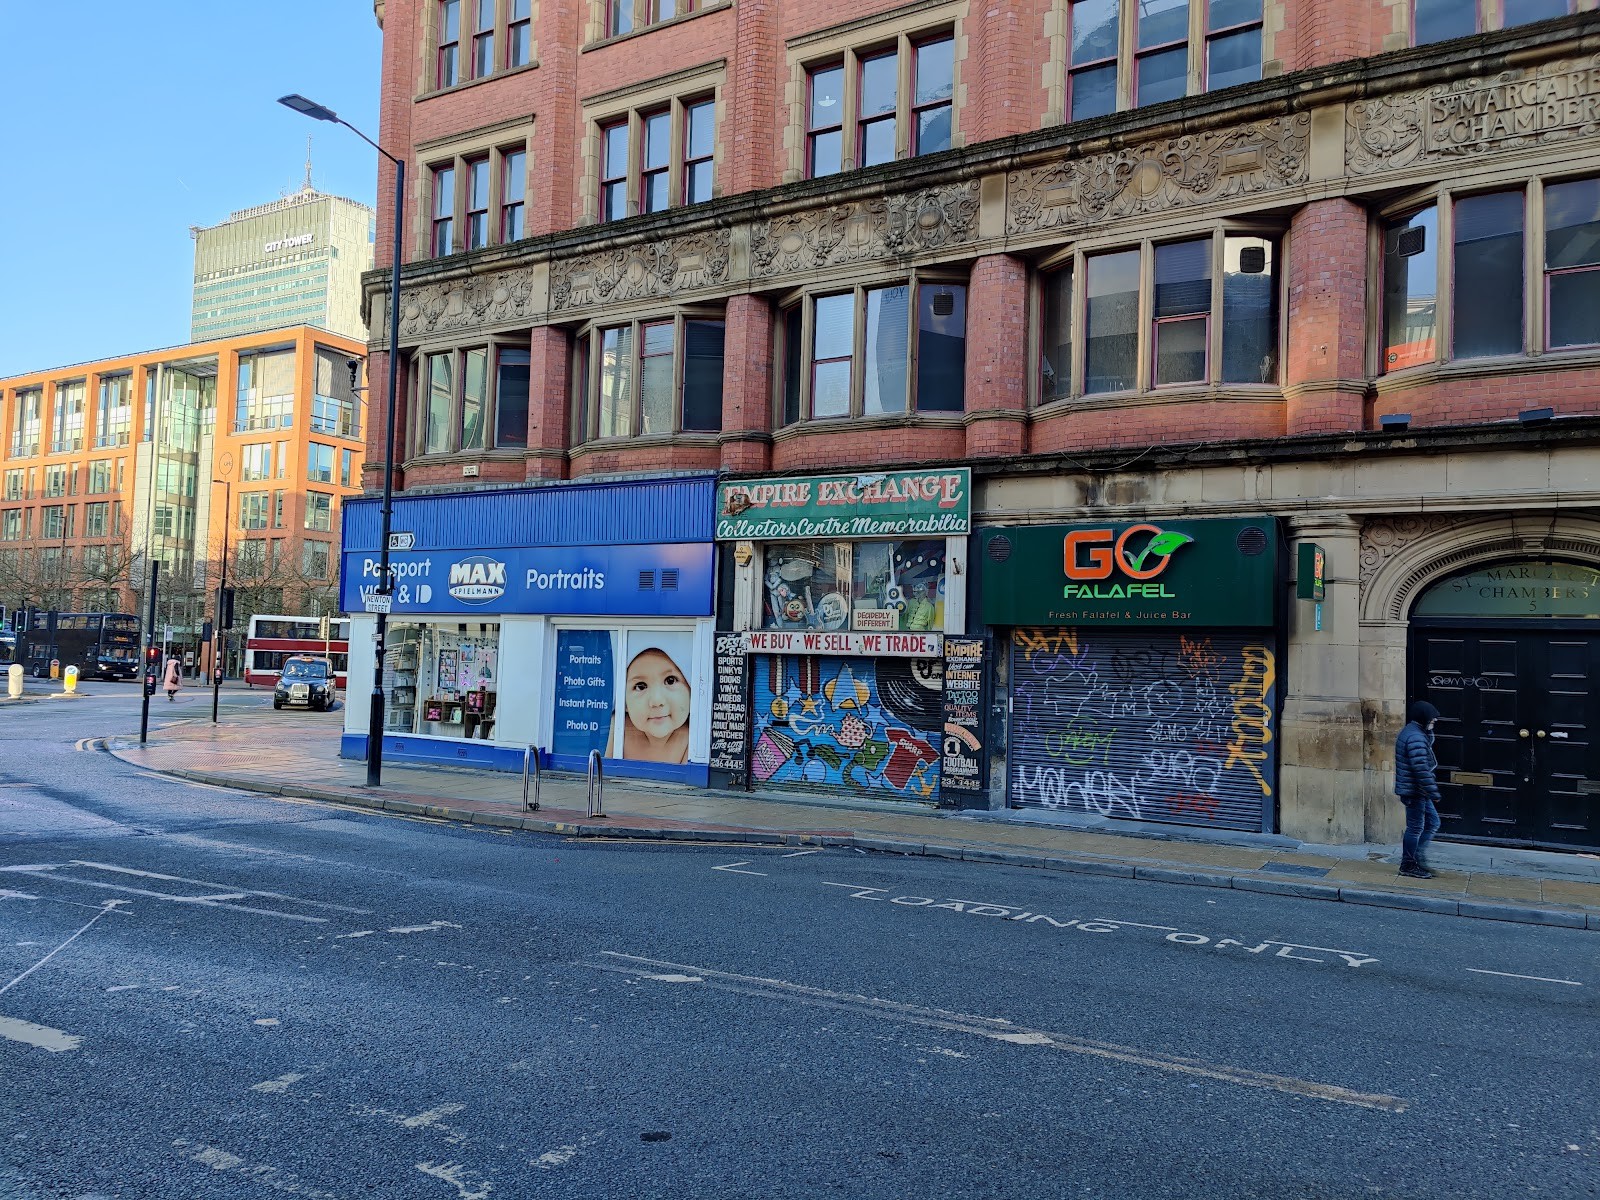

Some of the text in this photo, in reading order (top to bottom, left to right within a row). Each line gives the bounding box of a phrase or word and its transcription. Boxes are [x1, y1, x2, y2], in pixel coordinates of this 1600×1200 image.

[265, 234, 313, 253] CITY TOWER
[816, 474, 963, 508] EXCHANGE
[716, 513, 968, 539] Collectors Centre Memorabilia
[1063, 523, 1175, 580] GO
[363, 558, 431, 582] Pasport
[450, 563, 505, 585] MAX
[526, 567, 605, 590] Portraits
[397, 584, 410, 604] &
[415, 584, 432, 604] ID
[453, 587, 500, 596] SPIELMANN
[1063, 583, 1176, 599] FALAFEL
[1479, 586, 1590, 600] CHAMBERS
[366, 595, 391, 604] NEWTON
[367, 604, 388, 613] STREET
[1529, 600, 1537, 612] 5
[857, 611, 891, 621] DECIDEDLY
[1049, 610, 1193, 620] Fresh Falafel & Juice Bar
[750, 634, 769, 650] WE
[770, 633, 794, 650] BUY
[803, 635, 822, 651] WE
[824, 635, 852, 651] SELL
[862, 636, 884, 652] WE
[886, 636, 926, 653] TRADE
[944, 641, 982, 657] EMPIRE
[569, 654, 602, 664] Portraits
[718, 657, 743, 665] SPORTS
[945, 656, 981, 664] EXCHANGE
[718, 666, 743, 675] DINKYS
[945, 670, 981, 680] INTERNET
[563, 676, 606, 687] Photo Gifts
[719, 676, 741, 684] BOOKS
[945, 680, 980, 690] WEBSITE
[720, 685, 740, 693] VINYL
[718, 694, 742, 703] VIDEOS
[946, 690, 978, 701] TATTOO
[559, 698, 608, 710] Instant Prints
[954, 697, 979, 706] MAGS
[713, 703, 745, 713] CAMERAS
[713, 712, 745, 721] MILITARY
[566, 720, 599, 731] Photo ID
[712, 730, 744, 740] WATCHES
[942, 757, 979, 769] FOOTBALL
[849, 889, 1381, 968] LOADING ONLY
